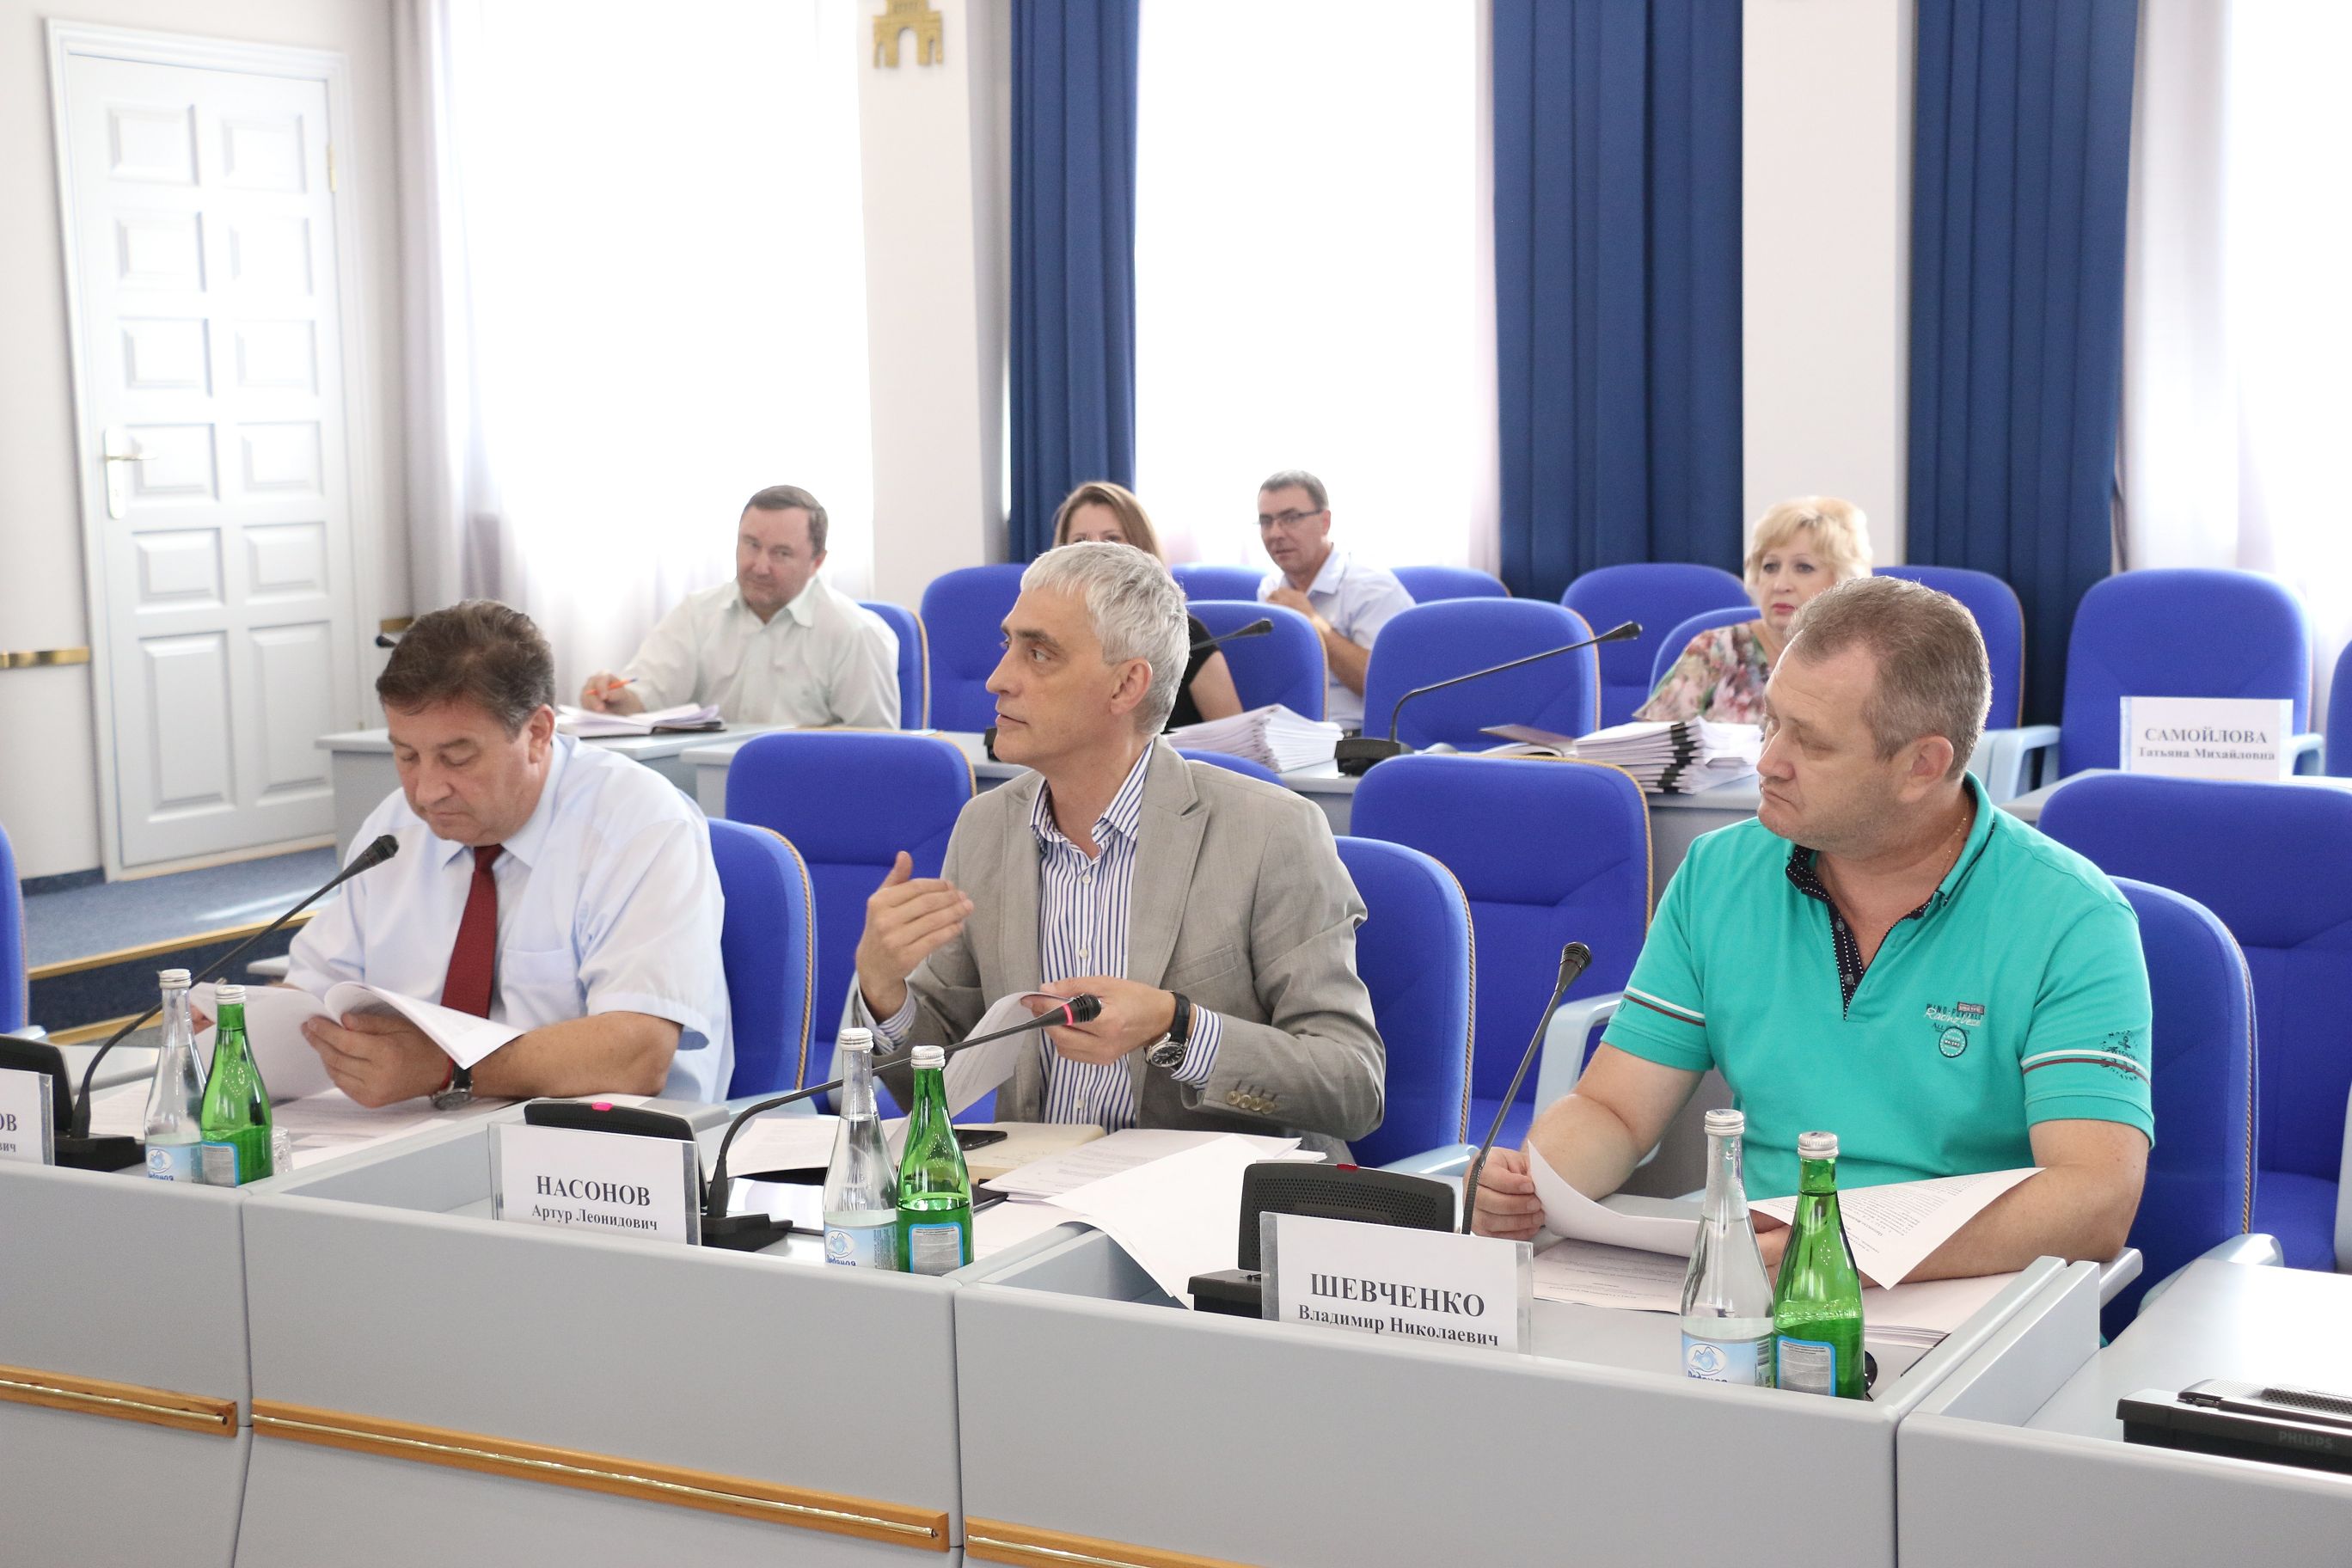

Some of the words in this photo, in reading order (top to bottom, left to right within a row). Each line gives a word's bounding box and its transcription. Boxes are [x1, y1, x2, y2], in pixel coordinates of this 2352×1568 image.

[2145, 726, 2268, 744] САМОЙЛОВА
[2138, 746, 2190, 758] Татьяна
[2194, 748, 2275, 761] Михайловна
[536, 1175, 651, 1206] НАСОНОВ
[531, 1204, 573, 1223] Артур
[576, 1209, 658, 1230] Леонидович
[1310, 1273, 1485, 1317] ШЕВЧЕНКО
[1298, 1304, 1384, 1333] Владимир
[1390, 1317, 1498, 1346] Николаевич
[2279, 1430, 2333, 1449] PHILIPS
